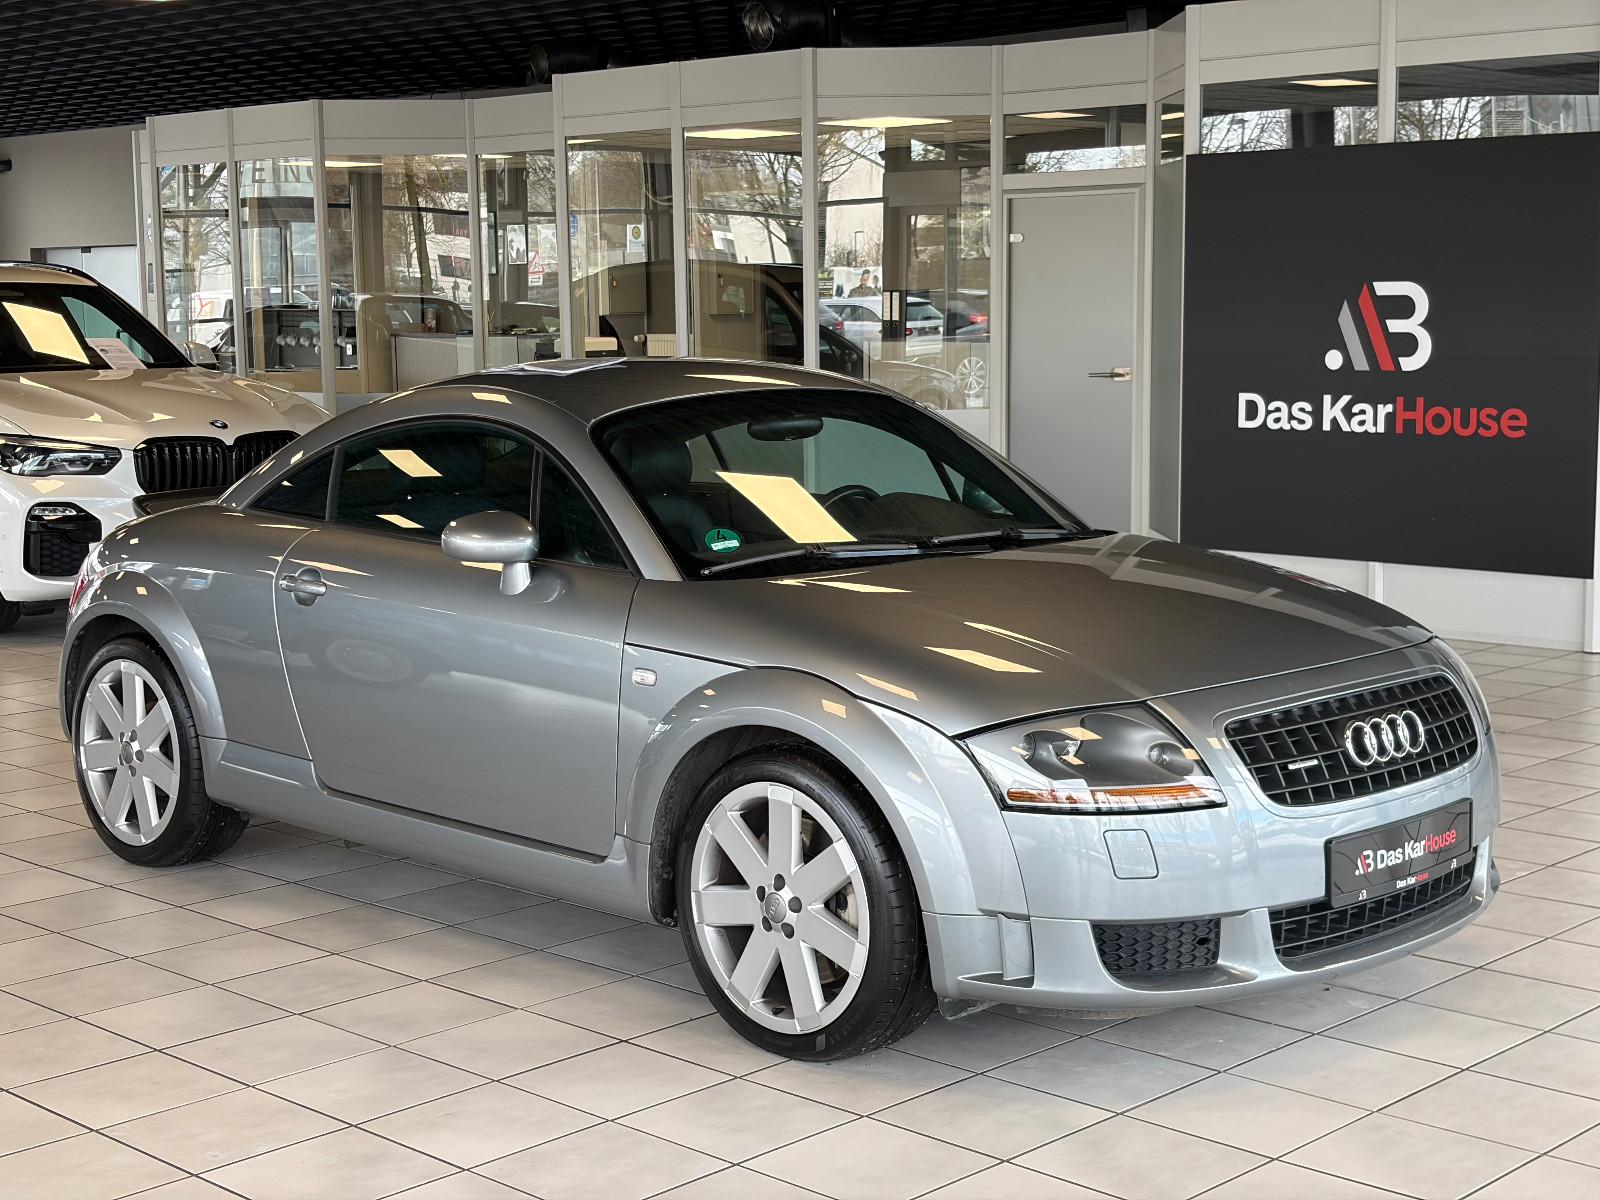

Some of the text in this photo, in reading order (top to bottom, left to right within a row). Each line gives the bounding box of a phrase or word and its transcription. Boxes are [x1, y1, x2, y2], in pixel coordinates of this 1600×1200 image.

[1237, 392, 1528, 439] Das KarHouse
[716, 529, 727, 541] 4
[1376, 847, 1404, 870] Das
[1396, 878, 1407, 889] Das
